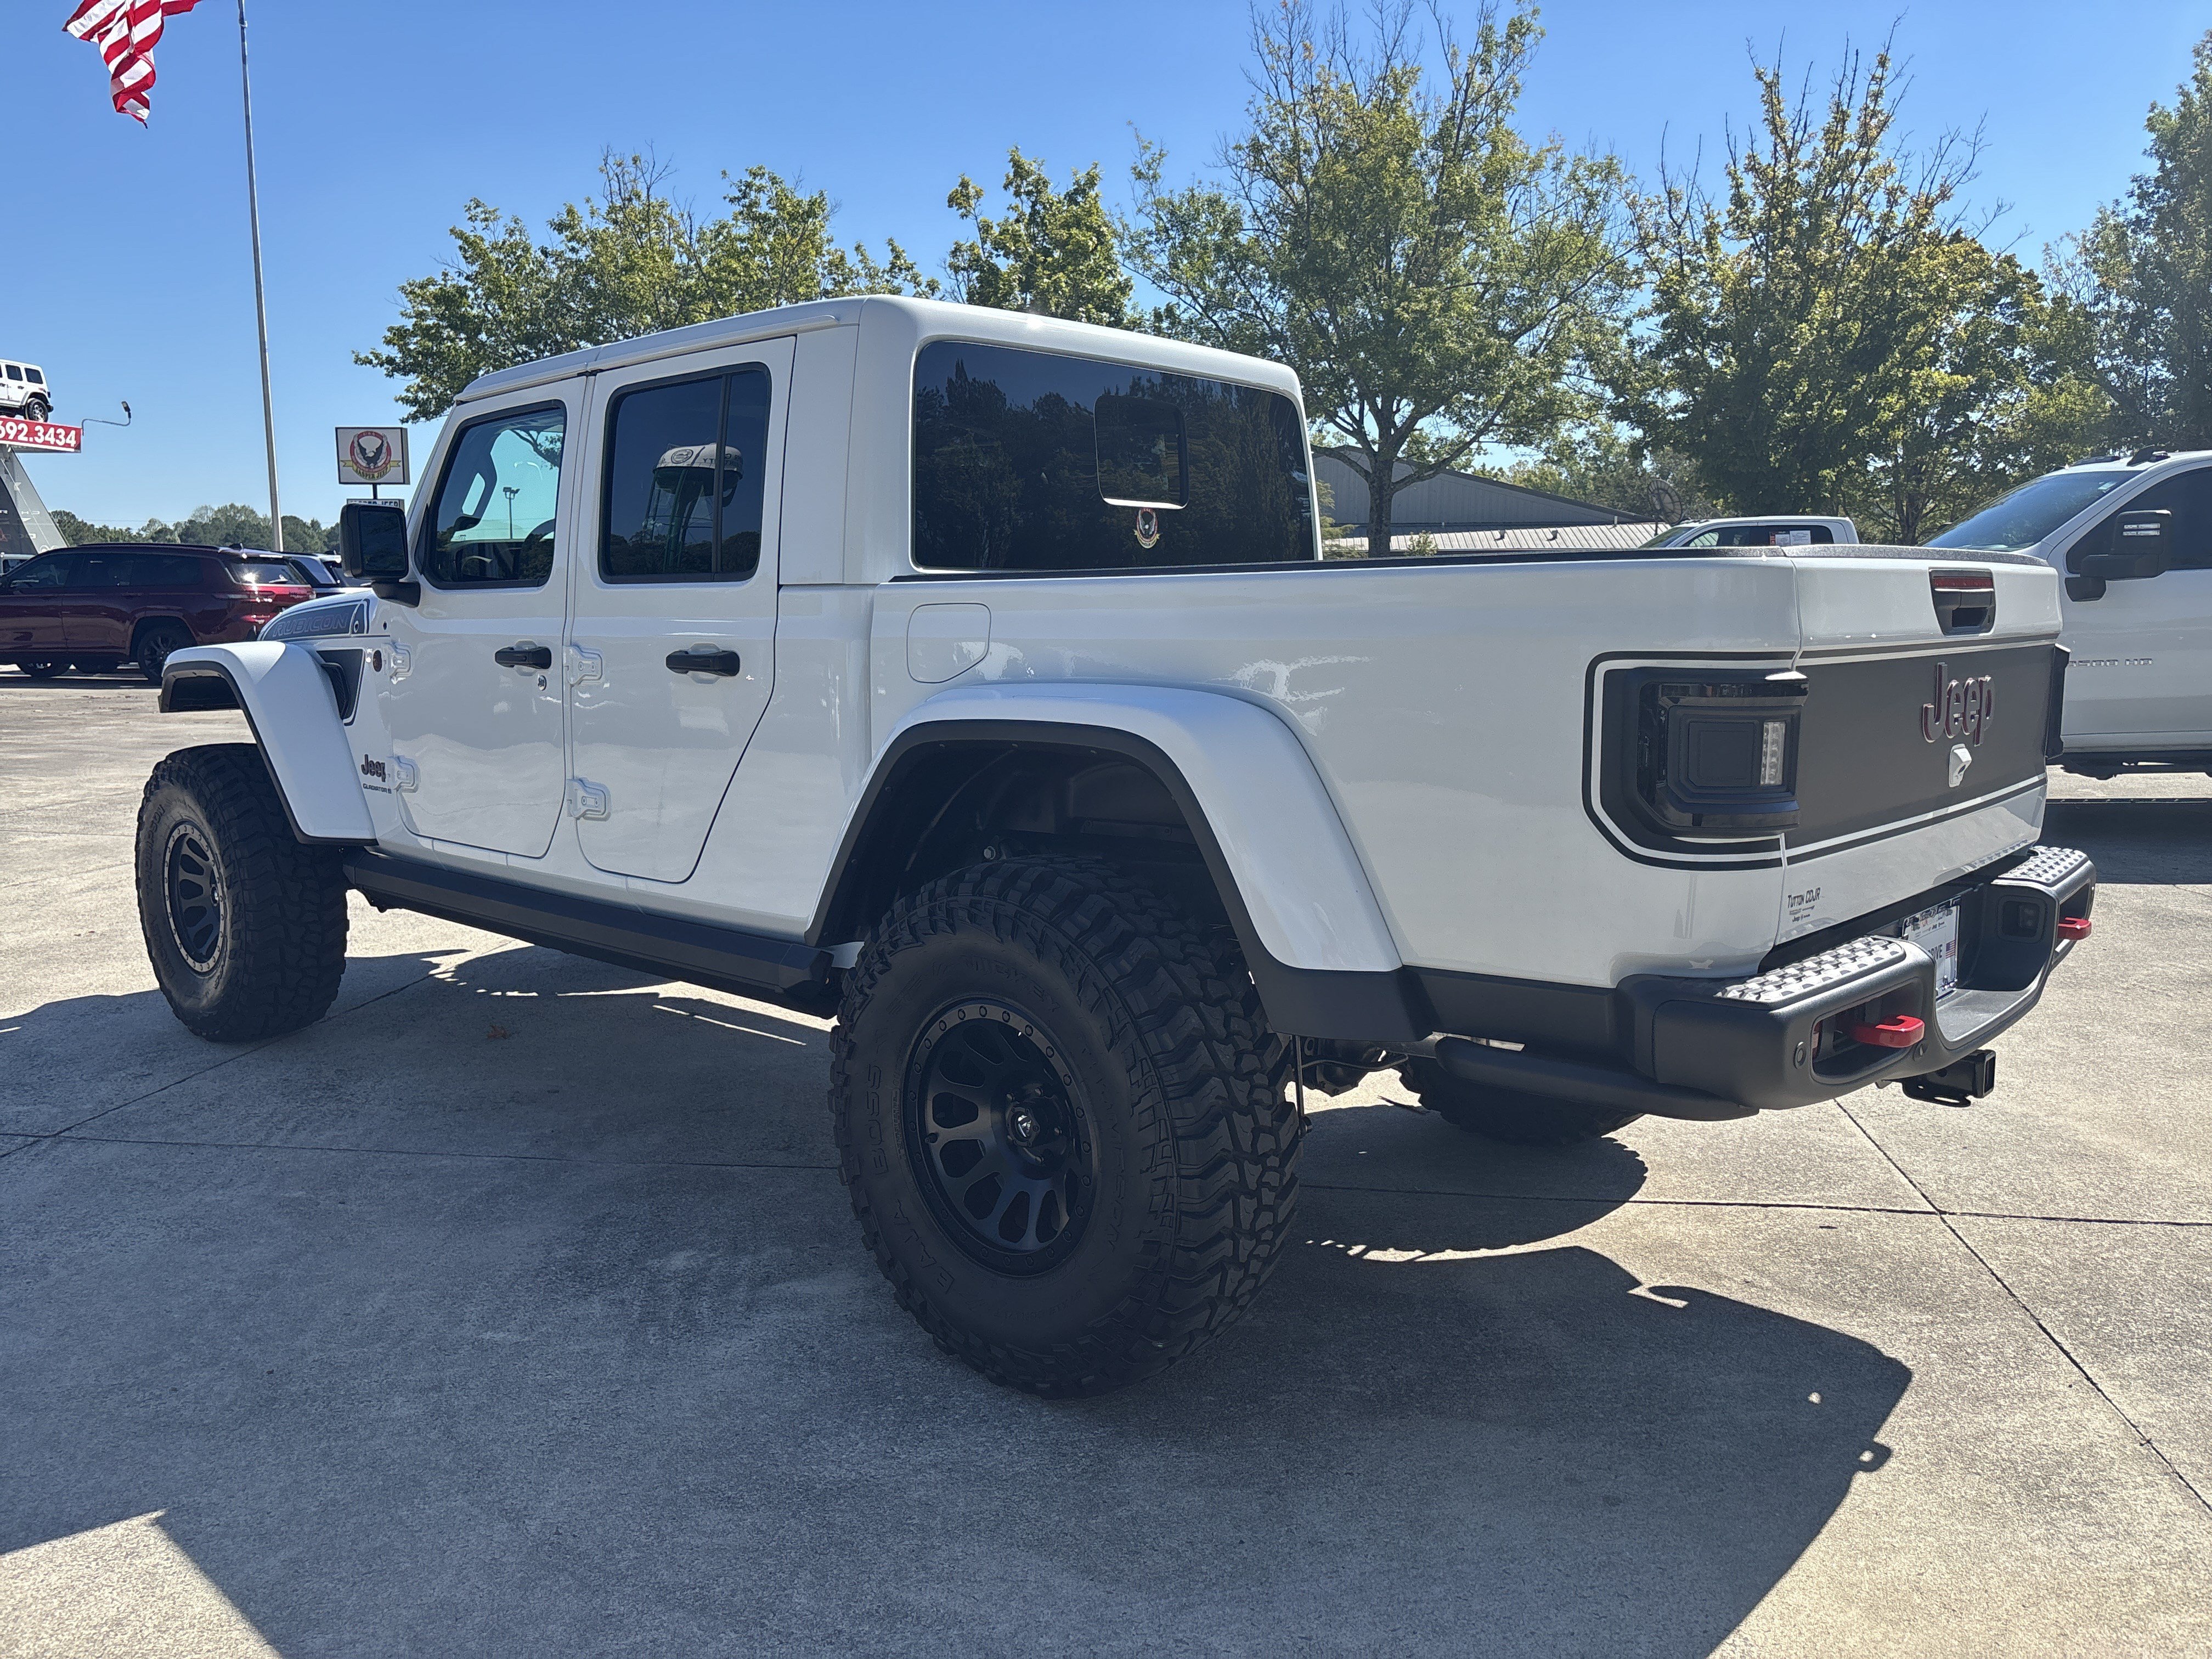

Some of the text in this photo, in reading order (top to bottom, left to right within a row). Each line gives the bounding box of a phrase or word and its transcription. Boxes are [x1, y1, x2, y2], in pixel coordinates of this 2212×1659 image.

[272, 613, 348, 637] RUBICON
[1922, 662, 1995, 747] Jeep
[361, 754, 386, 782] Jeep
[363, 783, 387, 793] GLADIATOR
[865, 1064, 889, 1176] BOSS
[893, 1197, 955, 1295] BAJA
